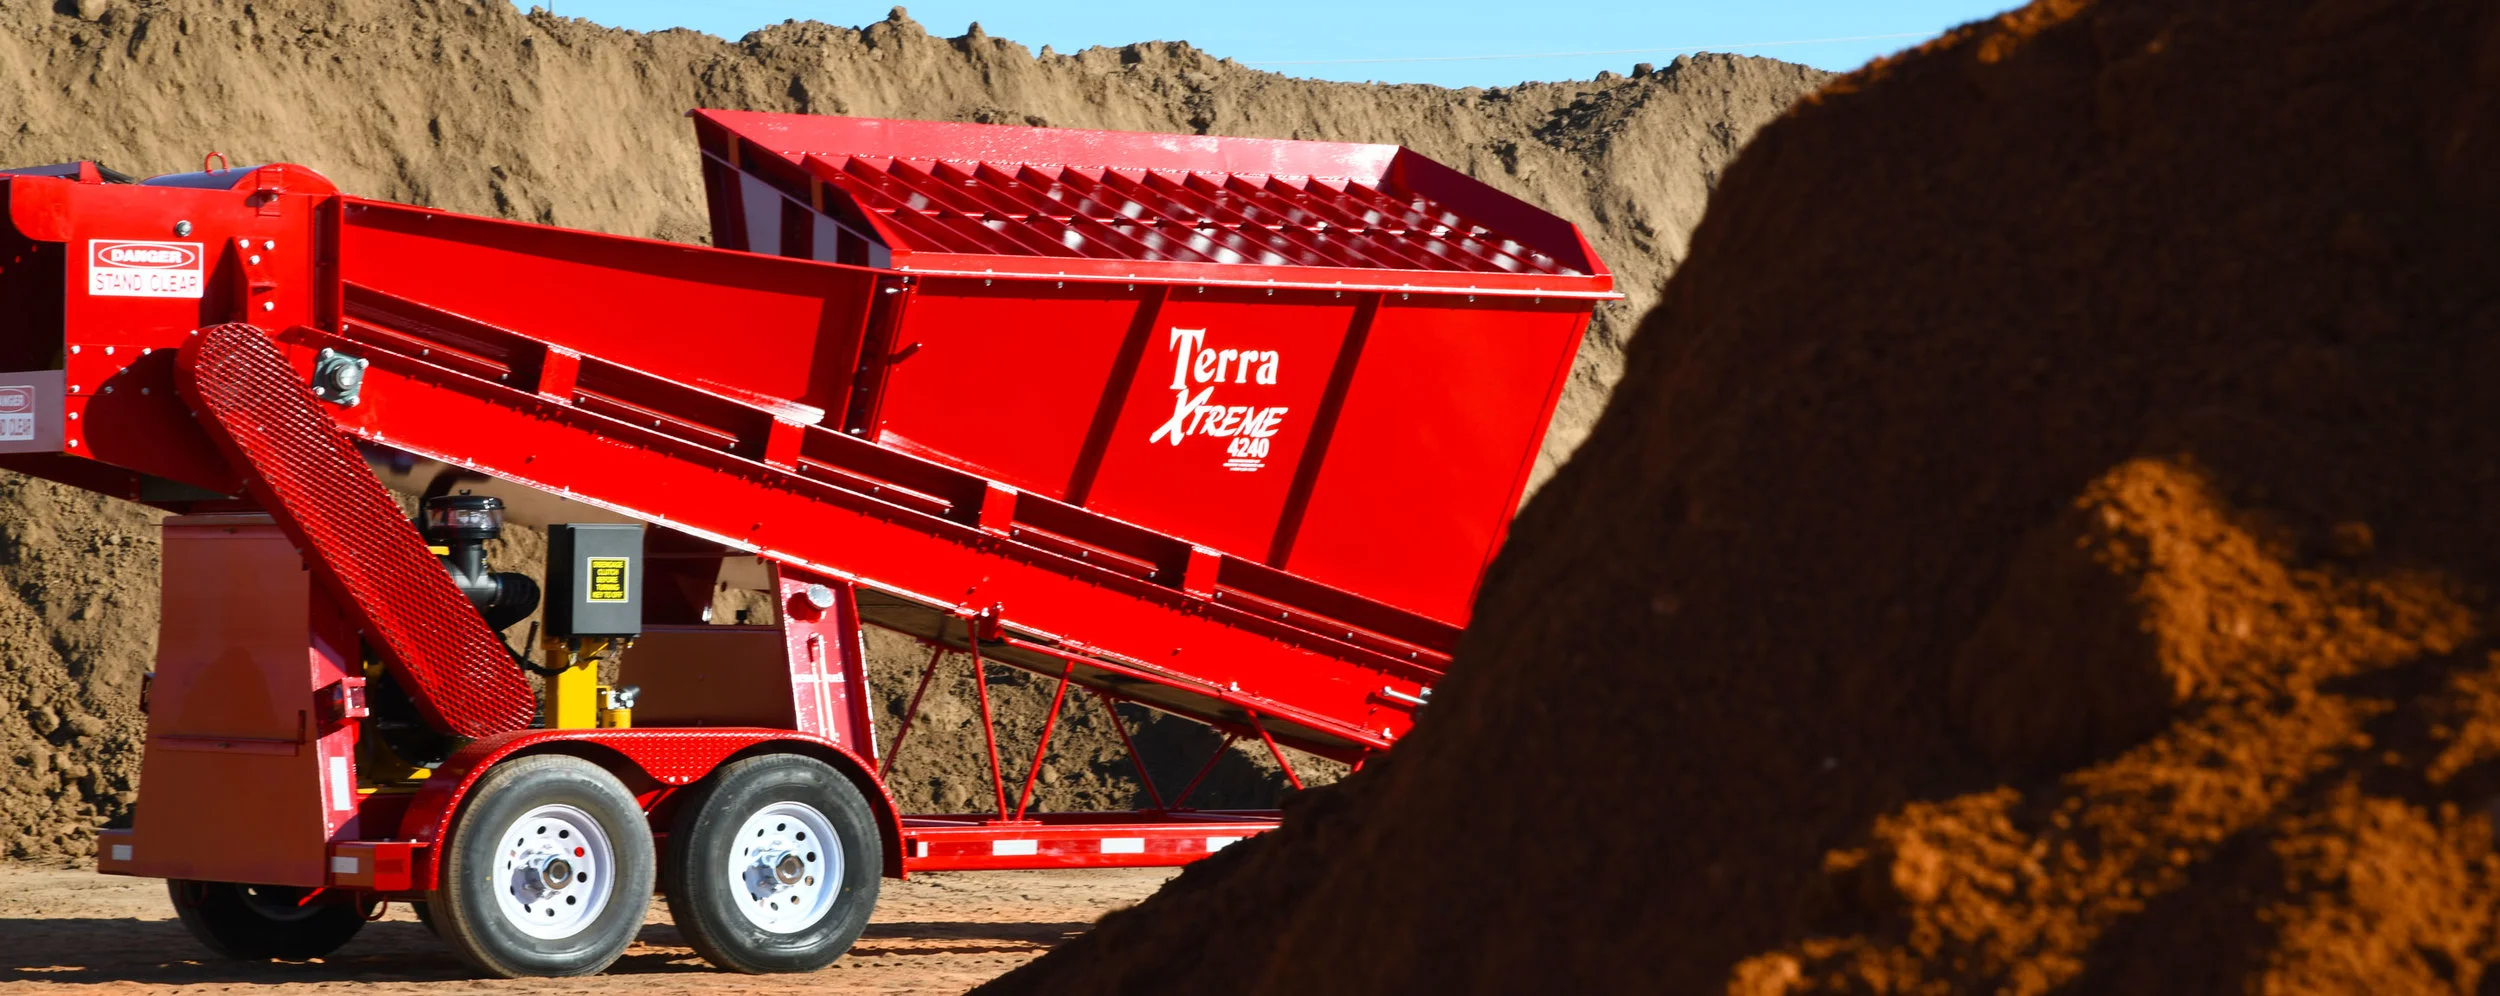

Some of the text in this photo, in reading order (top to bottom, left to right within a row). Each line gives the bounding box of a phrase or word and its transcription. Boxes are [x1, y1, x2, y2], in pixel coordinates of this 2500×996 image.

[111, 249, 182, 263] DANGER
[96, 273, 197, 292] STAND CLEAR
[1169, 327, 1279, 389] Terra
[1149, 386, 1289, 446] XTREME
[1227, 437, 1270, 458] 4240
